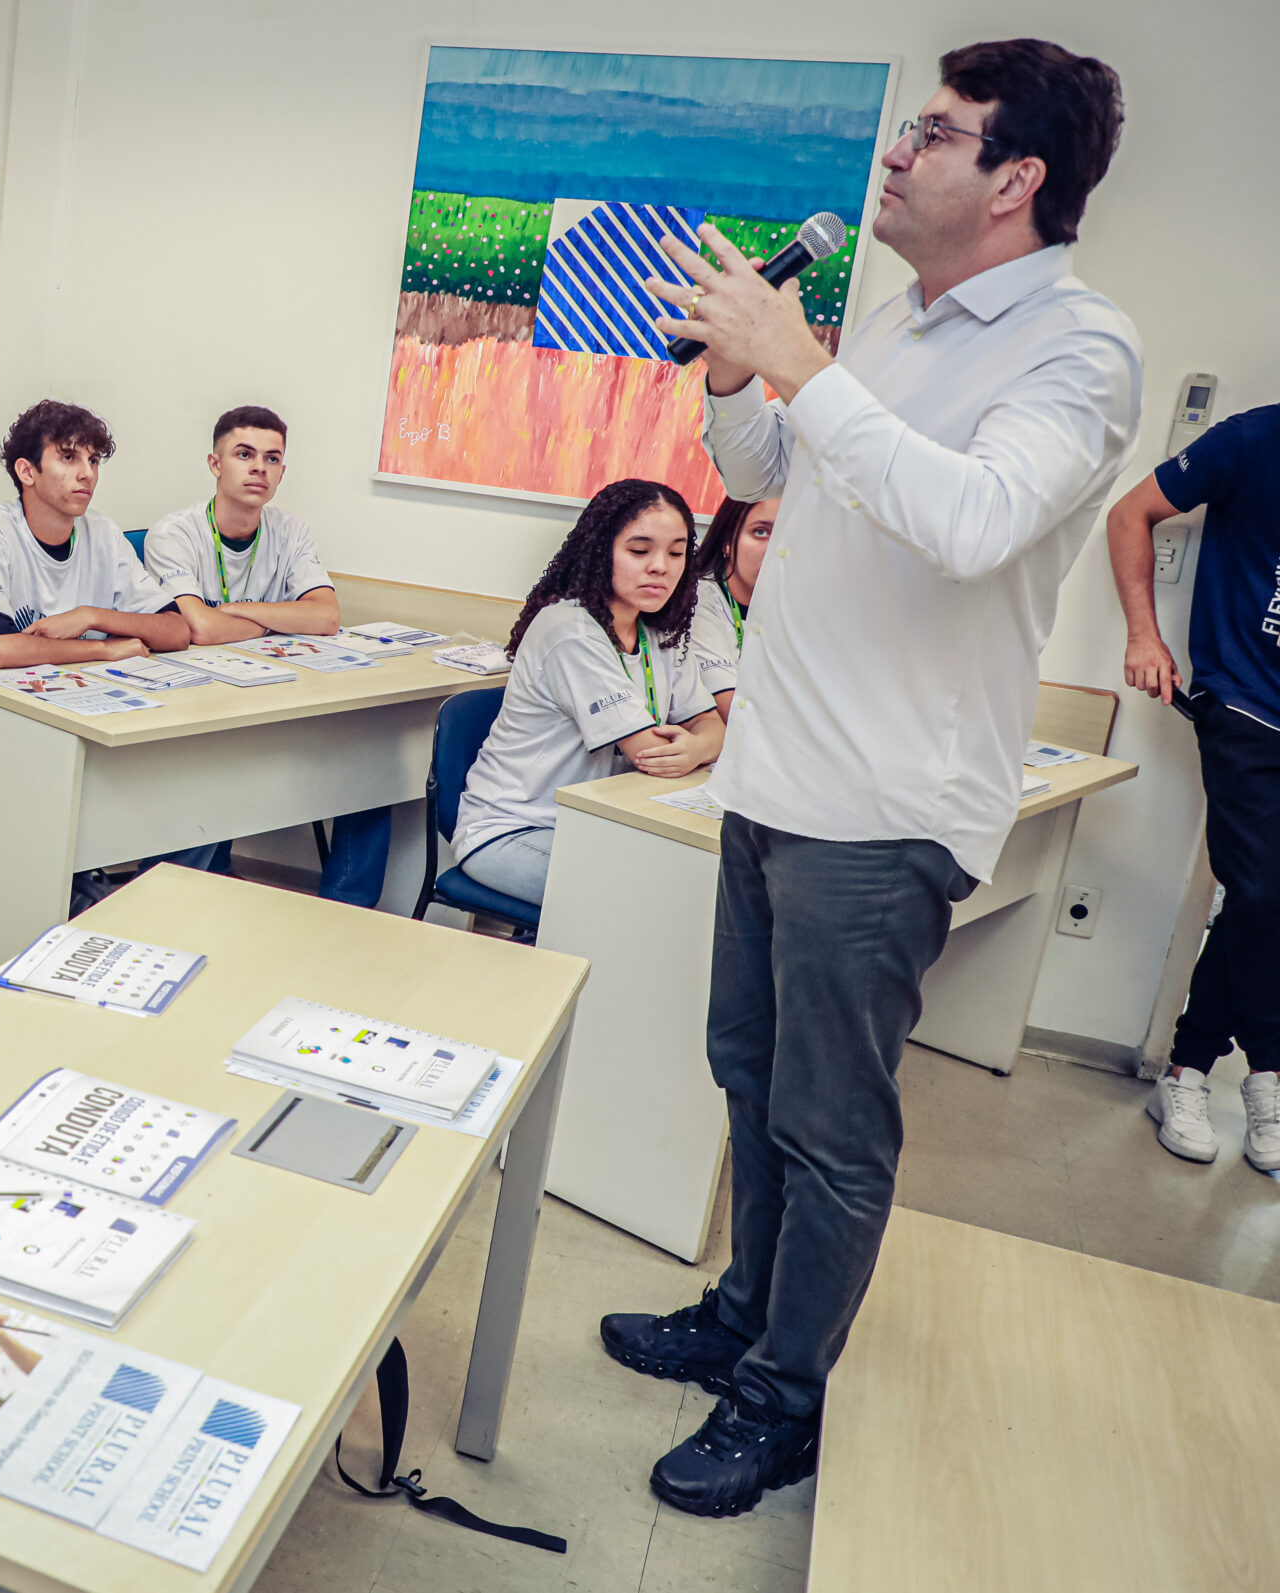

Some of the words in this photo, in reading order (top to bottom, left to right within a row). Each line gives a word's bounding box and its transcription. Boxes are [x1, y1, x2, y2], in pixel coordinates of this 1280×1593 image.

[399, 417, 433, 446] Enzo
[437, 422, 451, 442] B
[599, 690, 632, 706] PLURAL
[51, 936, 114, 982] CONDUTA
[418, 1060, 449, 1089] PLURAL
[34, 1087, 124, 1156] CONDUTA
[72, 1401, 106, 1438] PRINT
[32, 1437, 78, 1484] SCHOOL
[70, 1412, 147, 1498] PLURAL
[171, 1436, 206, 1475] PRINT
[137, 1472, 181, 1523] SCHOOL
[175, 1449, 248, 1537] PLURAL
